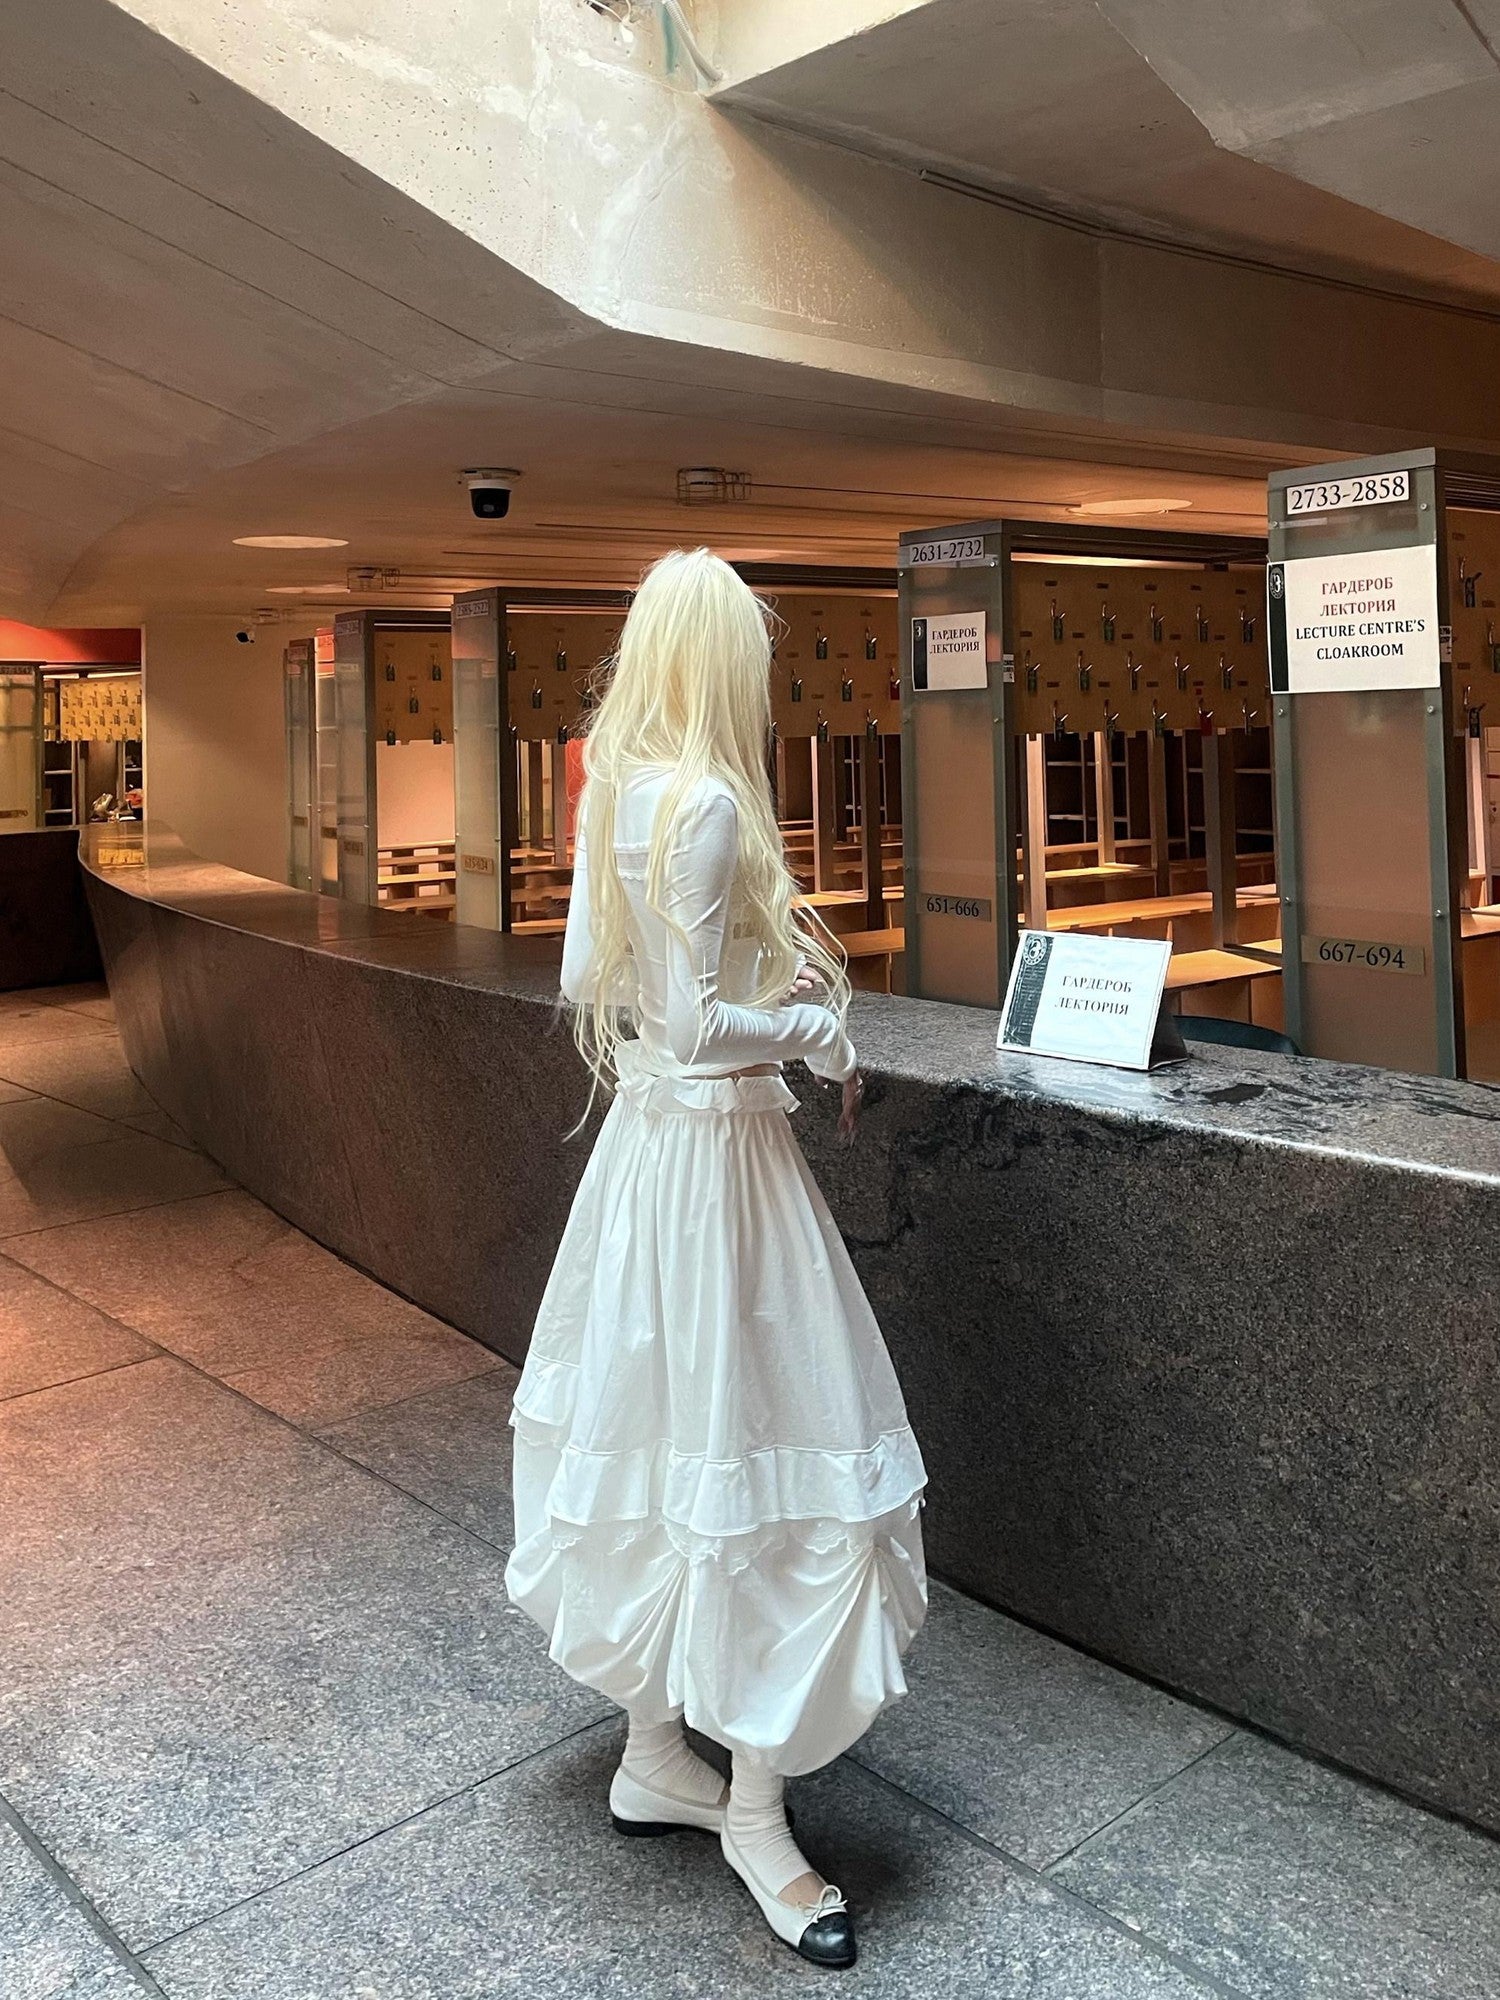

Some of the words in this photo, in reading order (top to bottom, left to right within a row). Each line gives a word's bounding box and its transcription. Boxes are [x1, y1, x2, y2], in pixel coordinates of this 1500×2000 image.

[1290, 475, 1405, 511] 2733-2858
[912, 539, 982, 563] 2631-2732
[1321, 576, 1394, 596] ГАРДЕРОБ
[1319, 598, 1396, 618] ЛЕКТОРИЯ
[931, 627, 978, 642] ГАРДЕРОБ
[1295, 624, 1356, 641] LECTURE
[1358, 618, 1426, 637] CENTRE'S
[929, 641, 980, 655] ЛЕКТОРИЯ
[1316, 643, 1404, 661] CLOAKROOM
[926, 896, 980, 918] 651-666
[1319, 941, 1406, 969] 667-694
[1062, 974, 1133, 994] ГАРДЕРОБ
[1054, 996, 1129, 1016] ЛЕКТОРИЯ
